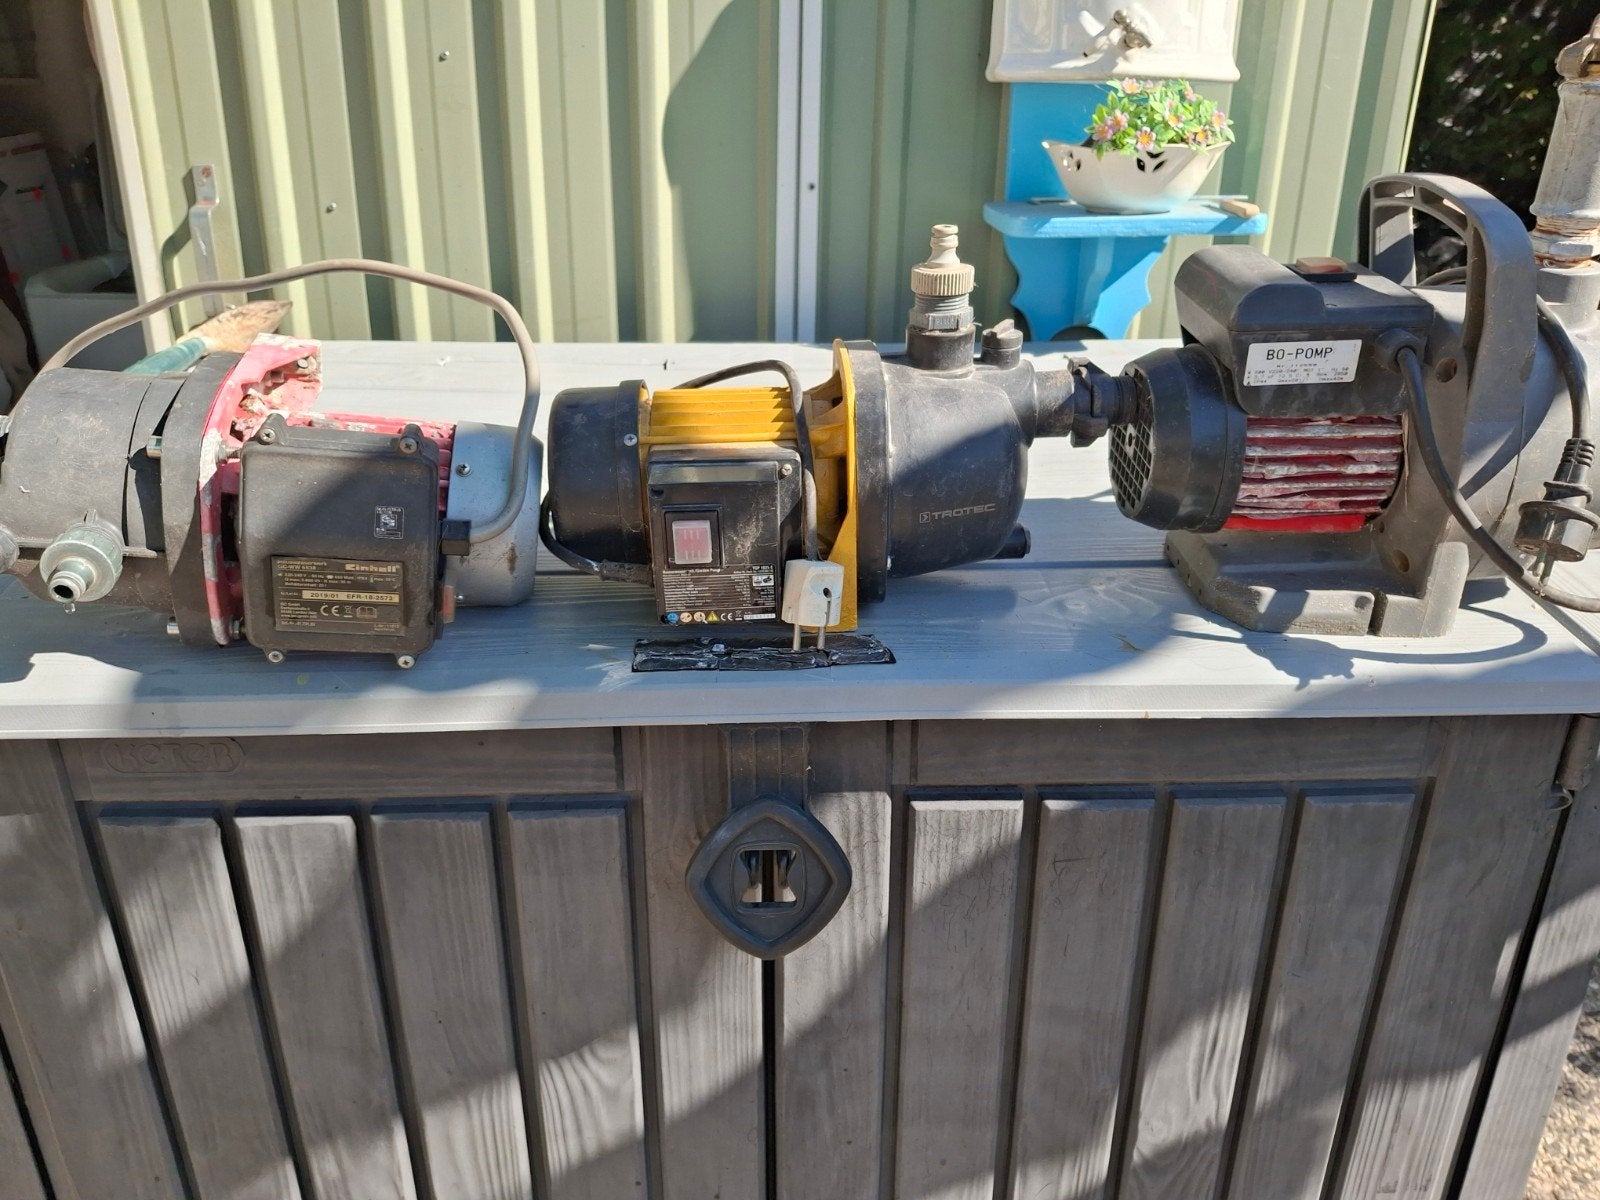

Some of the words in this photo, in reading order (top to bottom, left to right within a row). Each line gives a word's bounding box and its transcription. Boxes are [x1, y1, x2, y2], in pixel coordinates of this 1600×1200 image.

[1266, 347, 1333, 360] BO-POMP
[932, 503, 996, 520] TROTEC
[345, 563, 397, 573] Einhell
